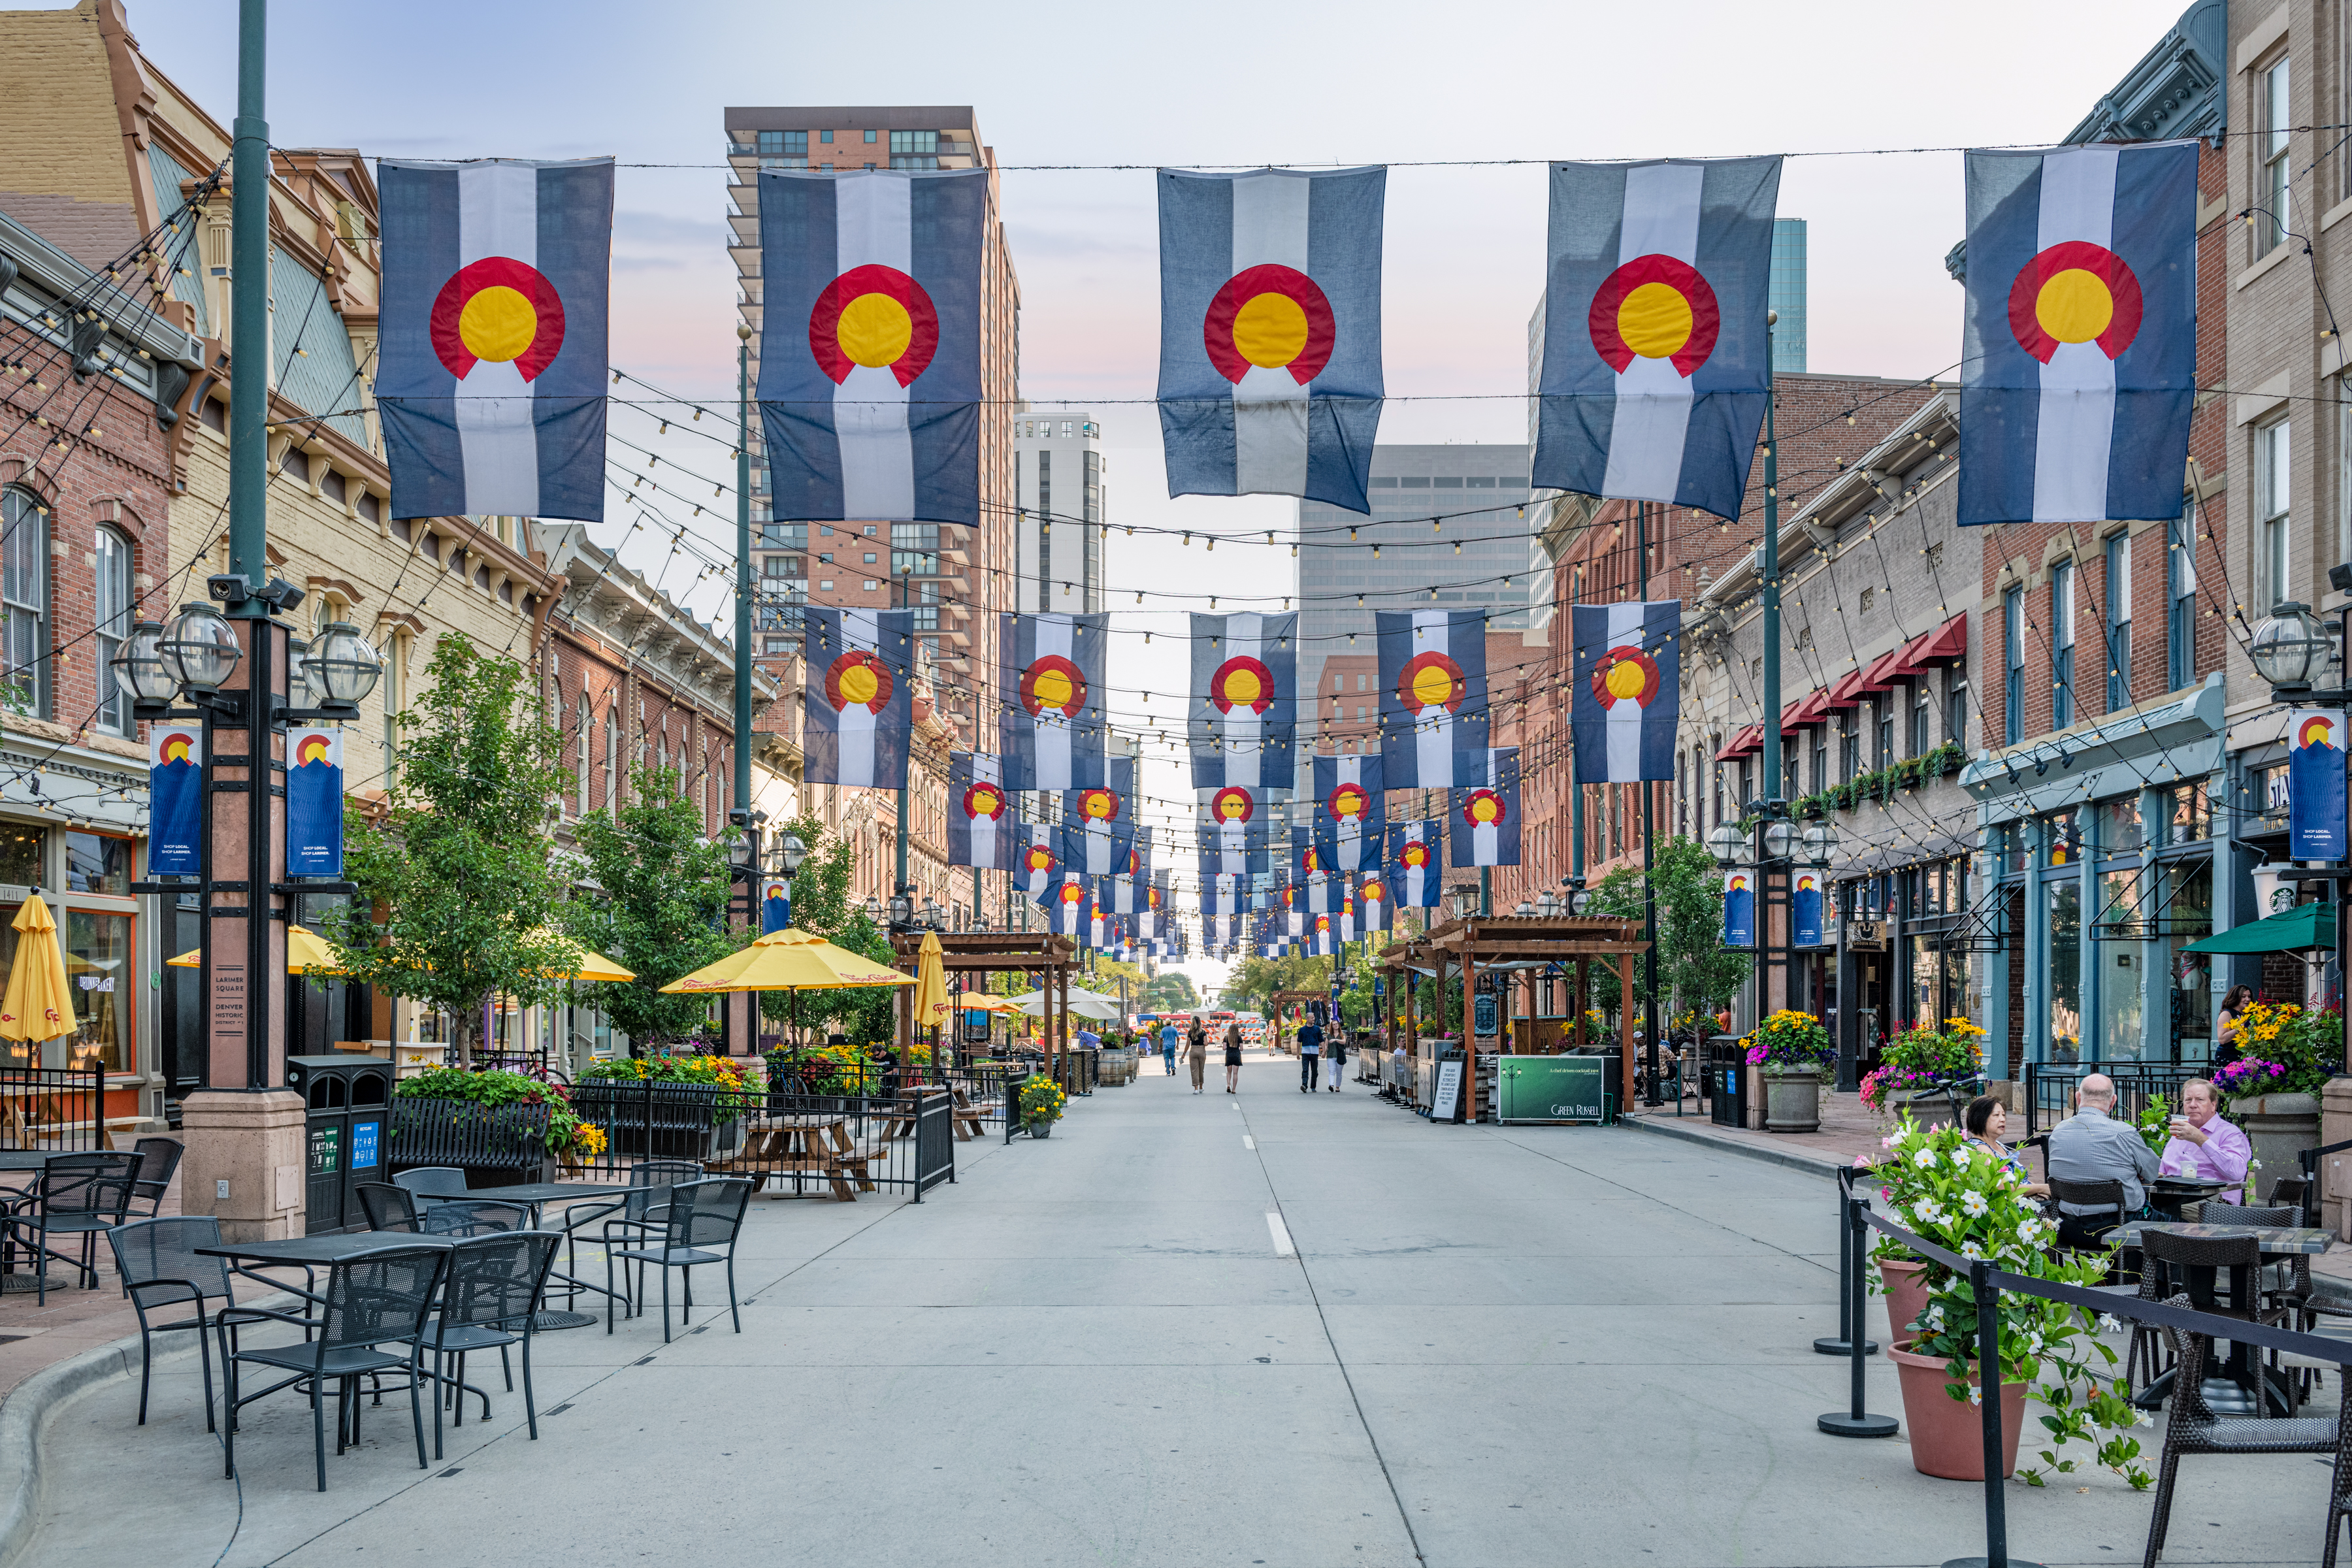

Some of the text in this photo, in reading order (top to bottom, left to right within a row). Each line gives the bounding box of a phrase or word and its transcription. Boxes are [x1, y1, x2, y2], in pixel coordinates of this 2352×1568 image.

[2269, 772, 2290, 809] STA
[3, 889, 18, 901] 1411
[79, 976, 101, 990] DRUNKEN
[97, 977, 115, 992] BAKERY
[1551, 1104, 1600, 1115] GREEN RUSSELL
